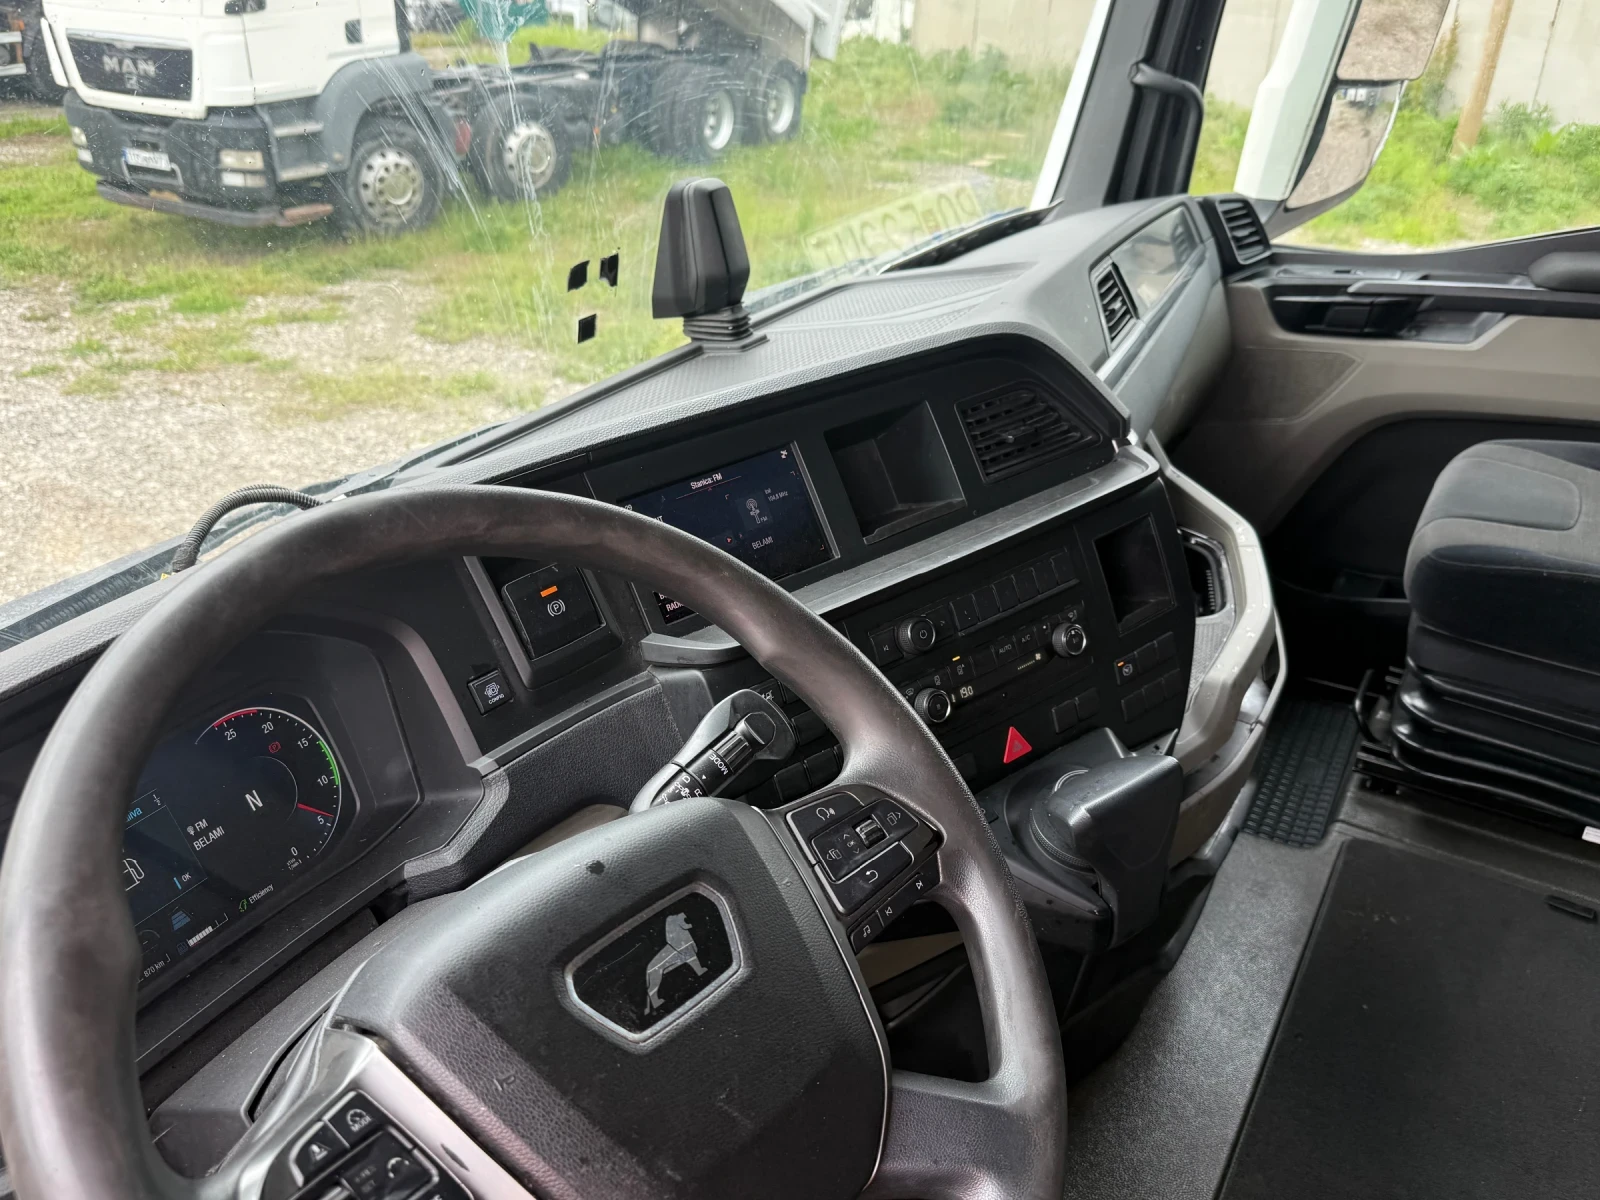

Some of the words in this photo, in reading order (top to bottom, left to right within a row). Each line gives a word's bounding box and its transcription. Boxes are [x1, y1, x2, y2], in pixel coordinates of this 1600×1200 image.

[102, 55, 156, 78] MAN
[690, 477, 713, 490] Stanica:
[712, 472, 723, 482] FM
[751, 536, 774, 550] BELAMI
[665, 601, 685, 612] RAD
[998, 643, 1012, 653] AUTO
[261, 722, 274, 734] 20
[224, 729, 237, 741] 25
[297, 738, 309, 749] 15
[708, 752, 729, 775] MODE
[317, 775, 329, 787] 10
[682, 775, 690, 783] D
[245, 789, 264, 812] N
[195, 819, 208, 831] FM
[317, 815, 325, 825] 5
[193, 826, 225, 851] BELAMI
[290, 847, 298, 856] 0
[181, 872, 191, 882] OK
[249, 883, 274, 904] Efficiency
[155, 959, 165, 972] km
